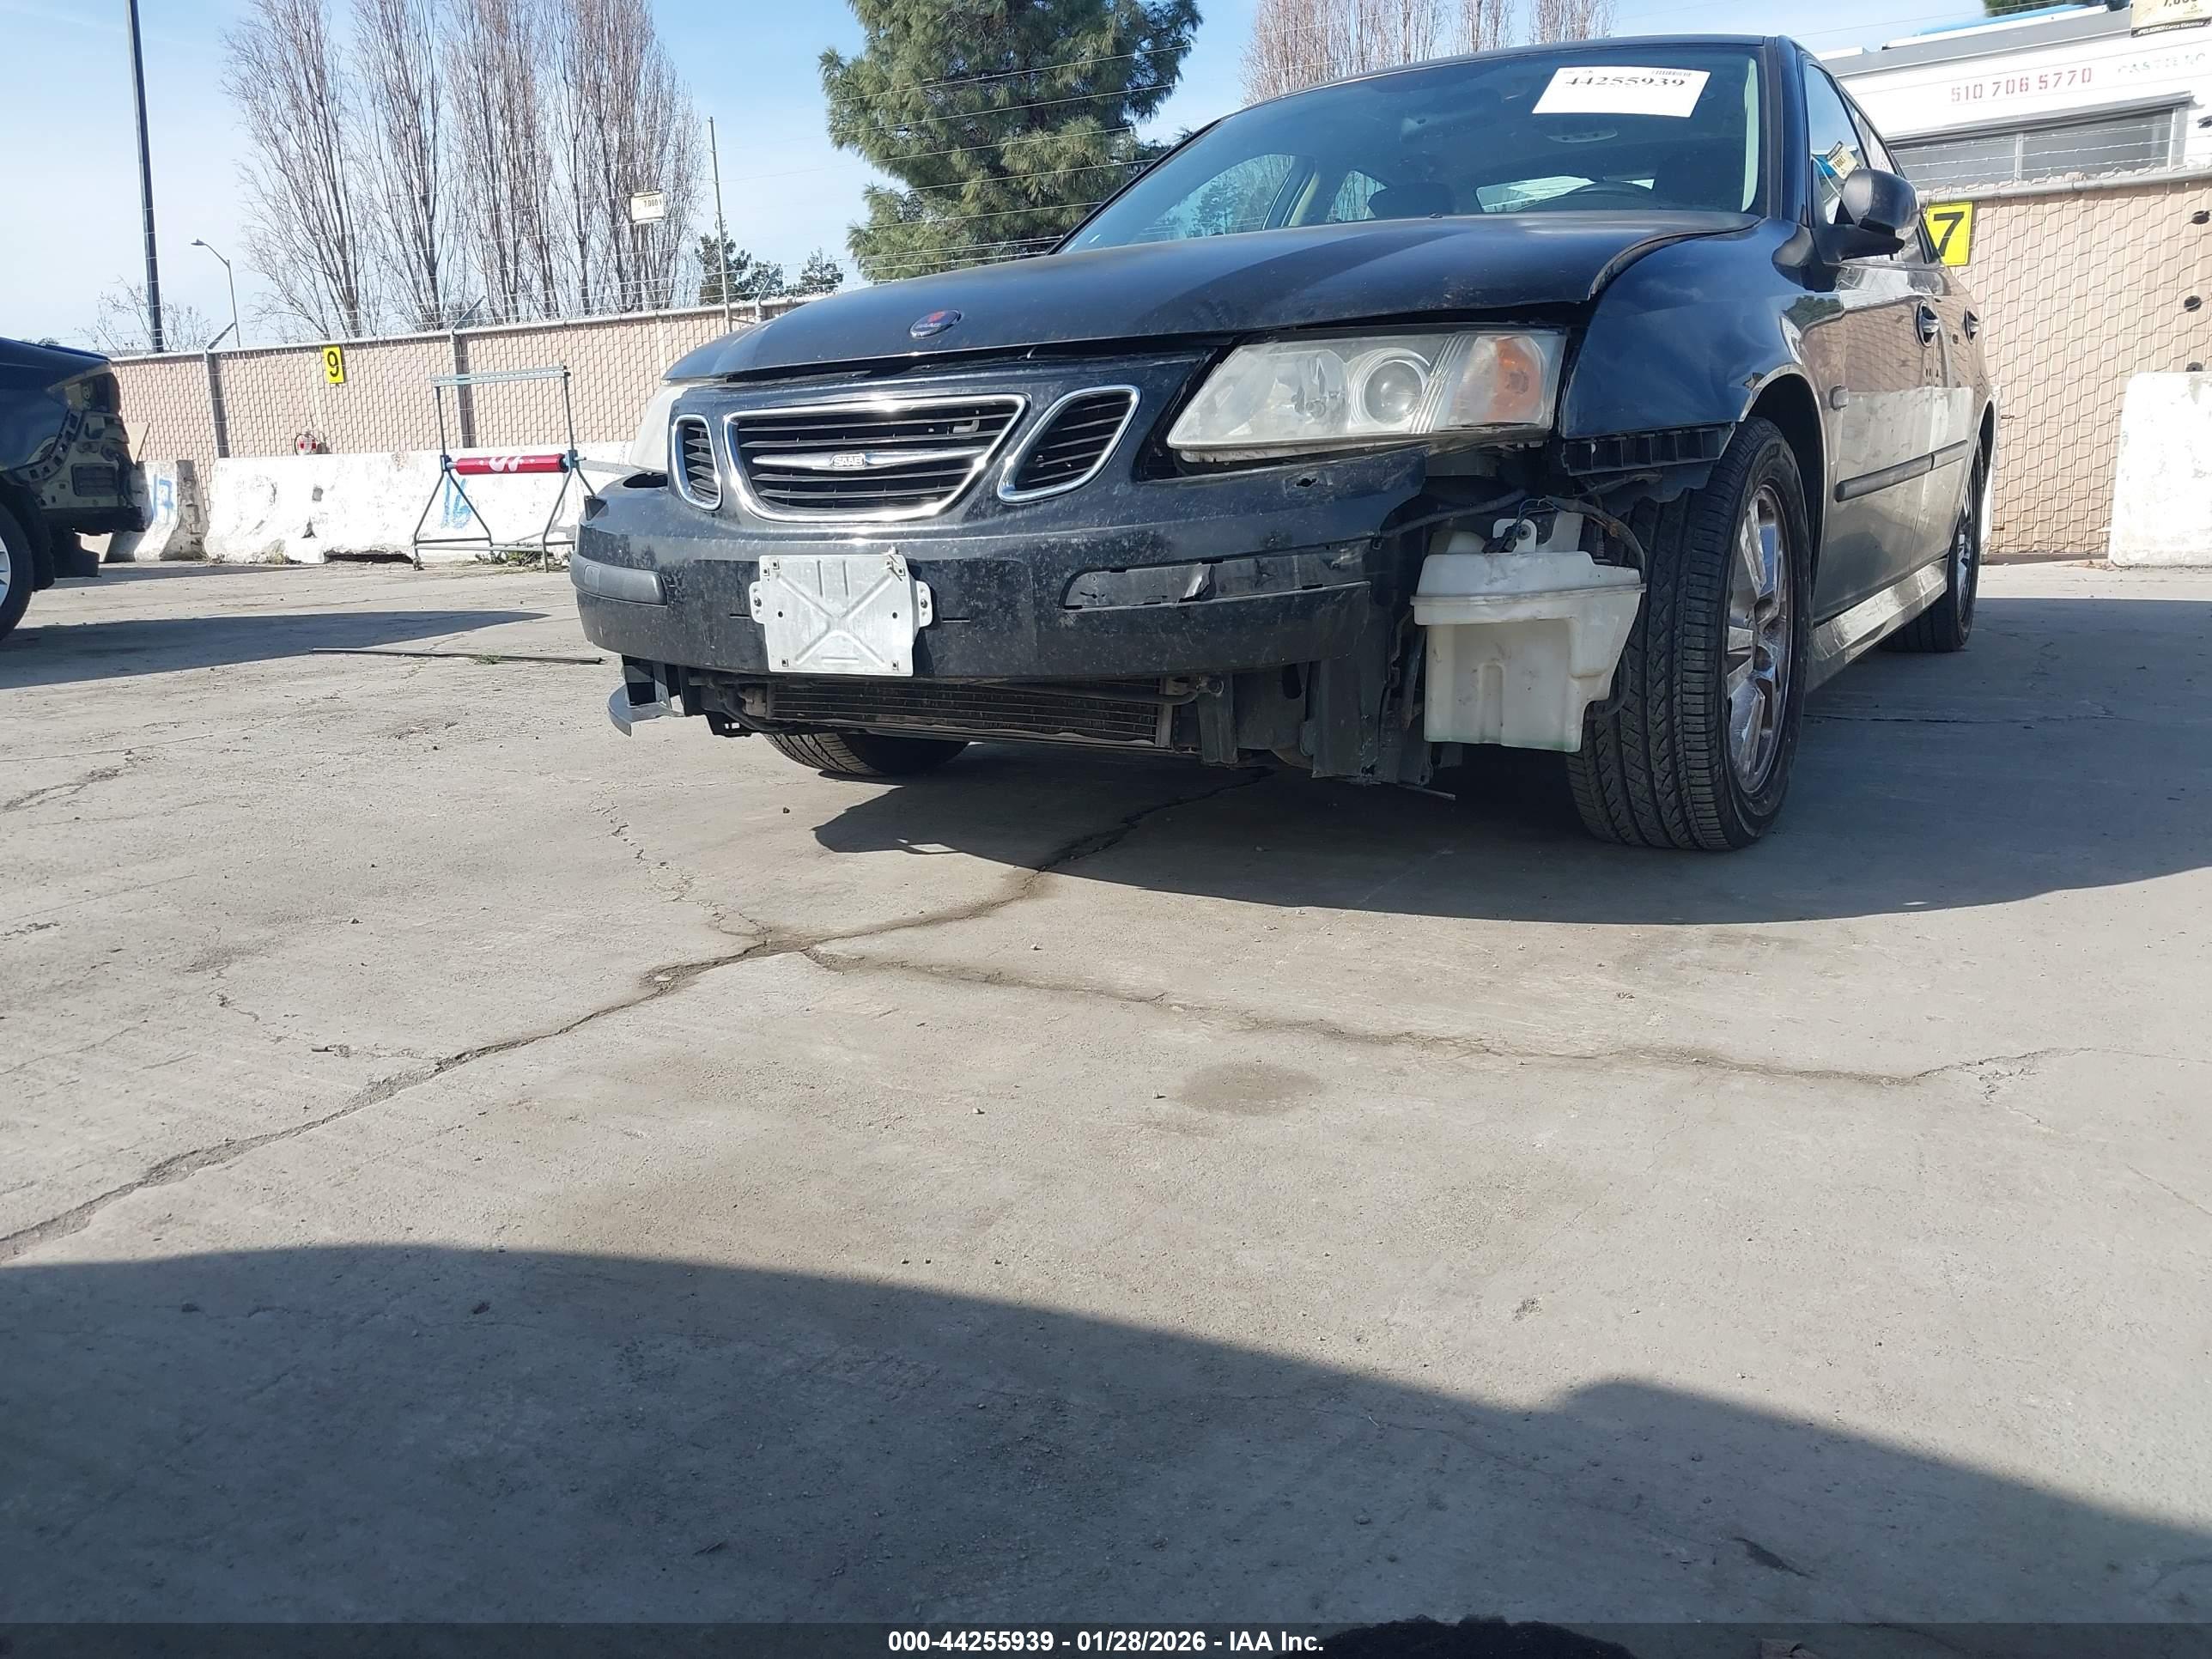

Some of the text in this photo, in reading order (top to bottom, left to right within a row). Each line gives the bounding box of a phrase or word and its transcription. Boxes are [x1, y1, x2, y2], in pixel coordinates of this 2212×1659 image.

[1565, 76, 1686, 87] 44255939
[1950, 83, 1983, 102] 510
[1992, 76, 2029, 97] 706
[2039, 67, 2093, 90] 5770
[1934, 211, 1965, 257] 7
[326, 350, 342, 377] 9
[833, 455, 863, 468] SAAB
